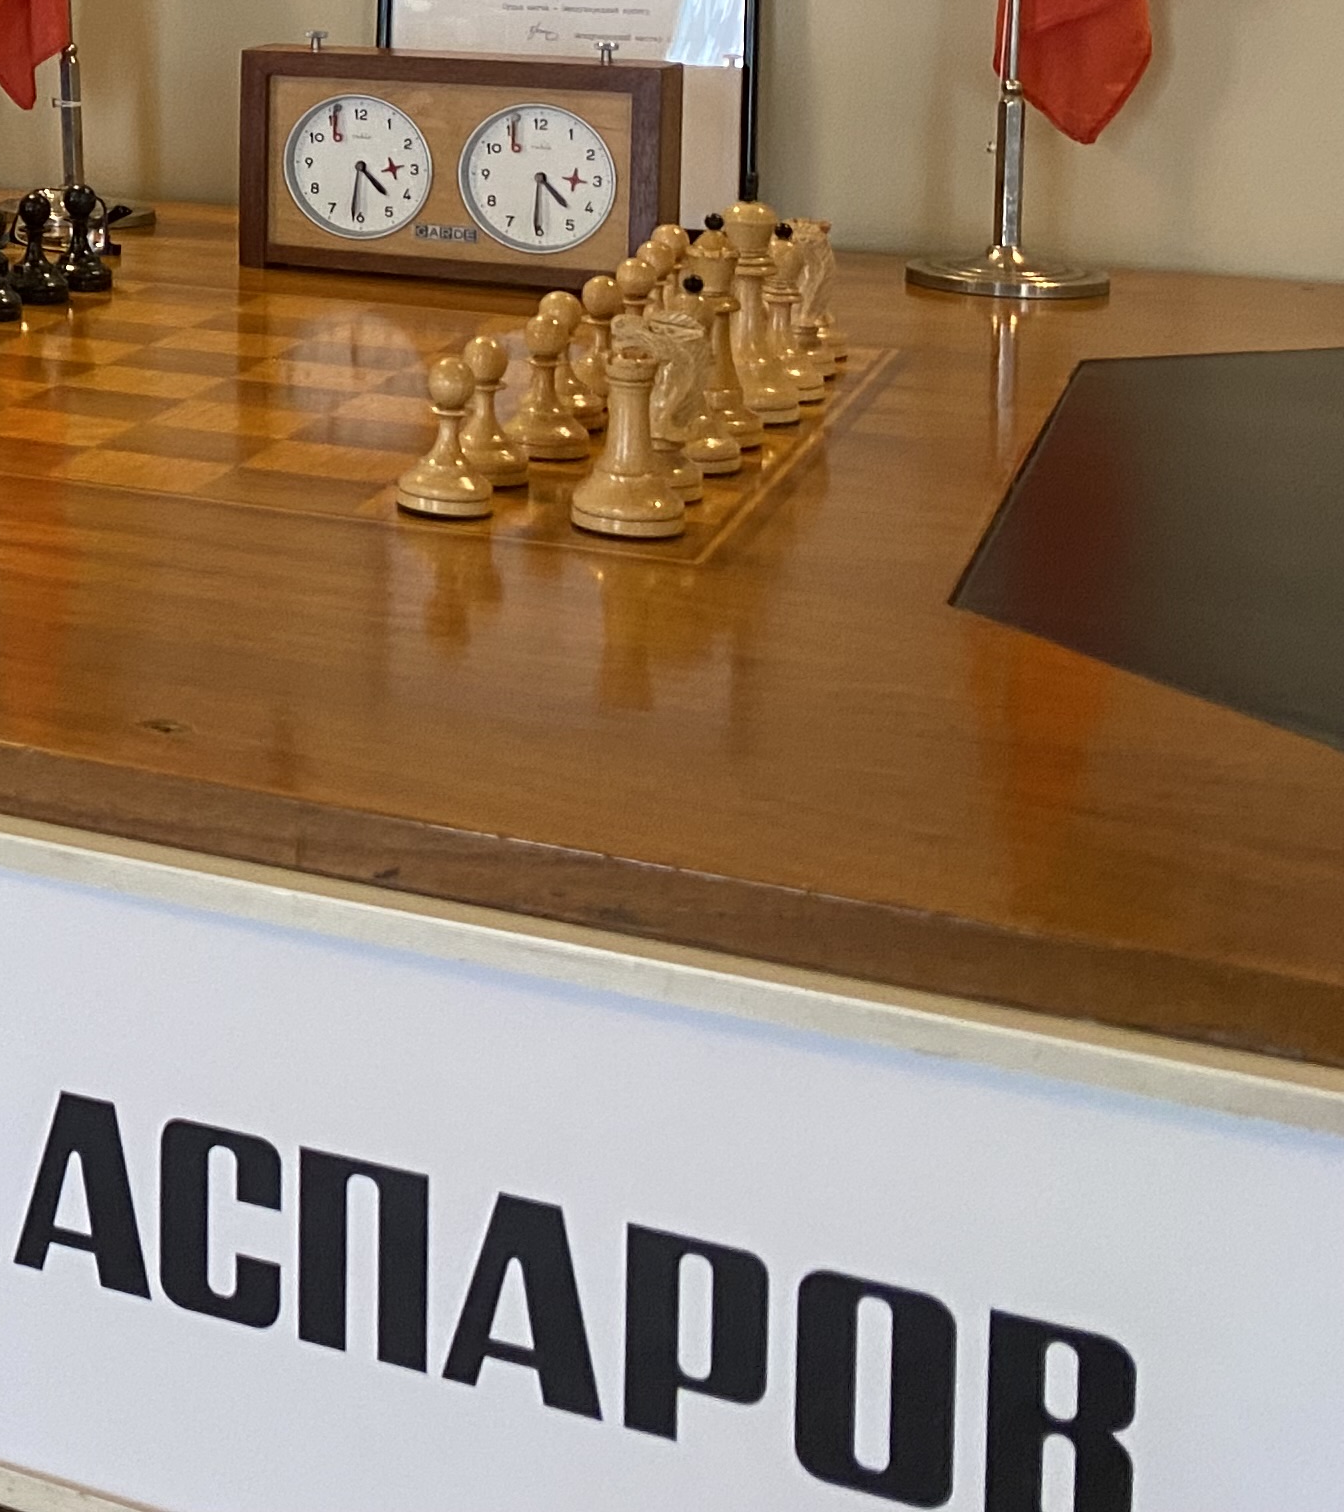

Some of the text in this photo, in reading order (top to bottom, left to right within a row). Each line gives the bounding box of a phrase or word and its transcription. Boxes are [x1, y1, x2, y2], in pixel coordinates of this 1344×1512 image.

[355, 109, 368, 121] 12
[533, 118, 548, 131] 12
[309, 132, 324, 143] 10
[404, 138, 413, 150] 2
[487, 142, 502, 155] 10
[586, 148, 596, 161] 2
[304, 157, 314, 168] 9
[410, 164, 419, 176] 3
[481, 168, 491, 180] 9
[592, 175, 602, 188] 3
[310, 182, 320, 194] 8
[403, 188, 412, 200] 4
[487, 194, 497, 207] 8
[328, 202, 337, 214] 7
[384, 206, 393, 218] 5
[584, 201, 594, 214] 4
[356, 212, 365, 223] 6
[505, 215, 515, 227] 7
[535, 225, 545, 237] 6
[565, 219, 575, 231] 5
[415, 226, 477, 241] GARDE
